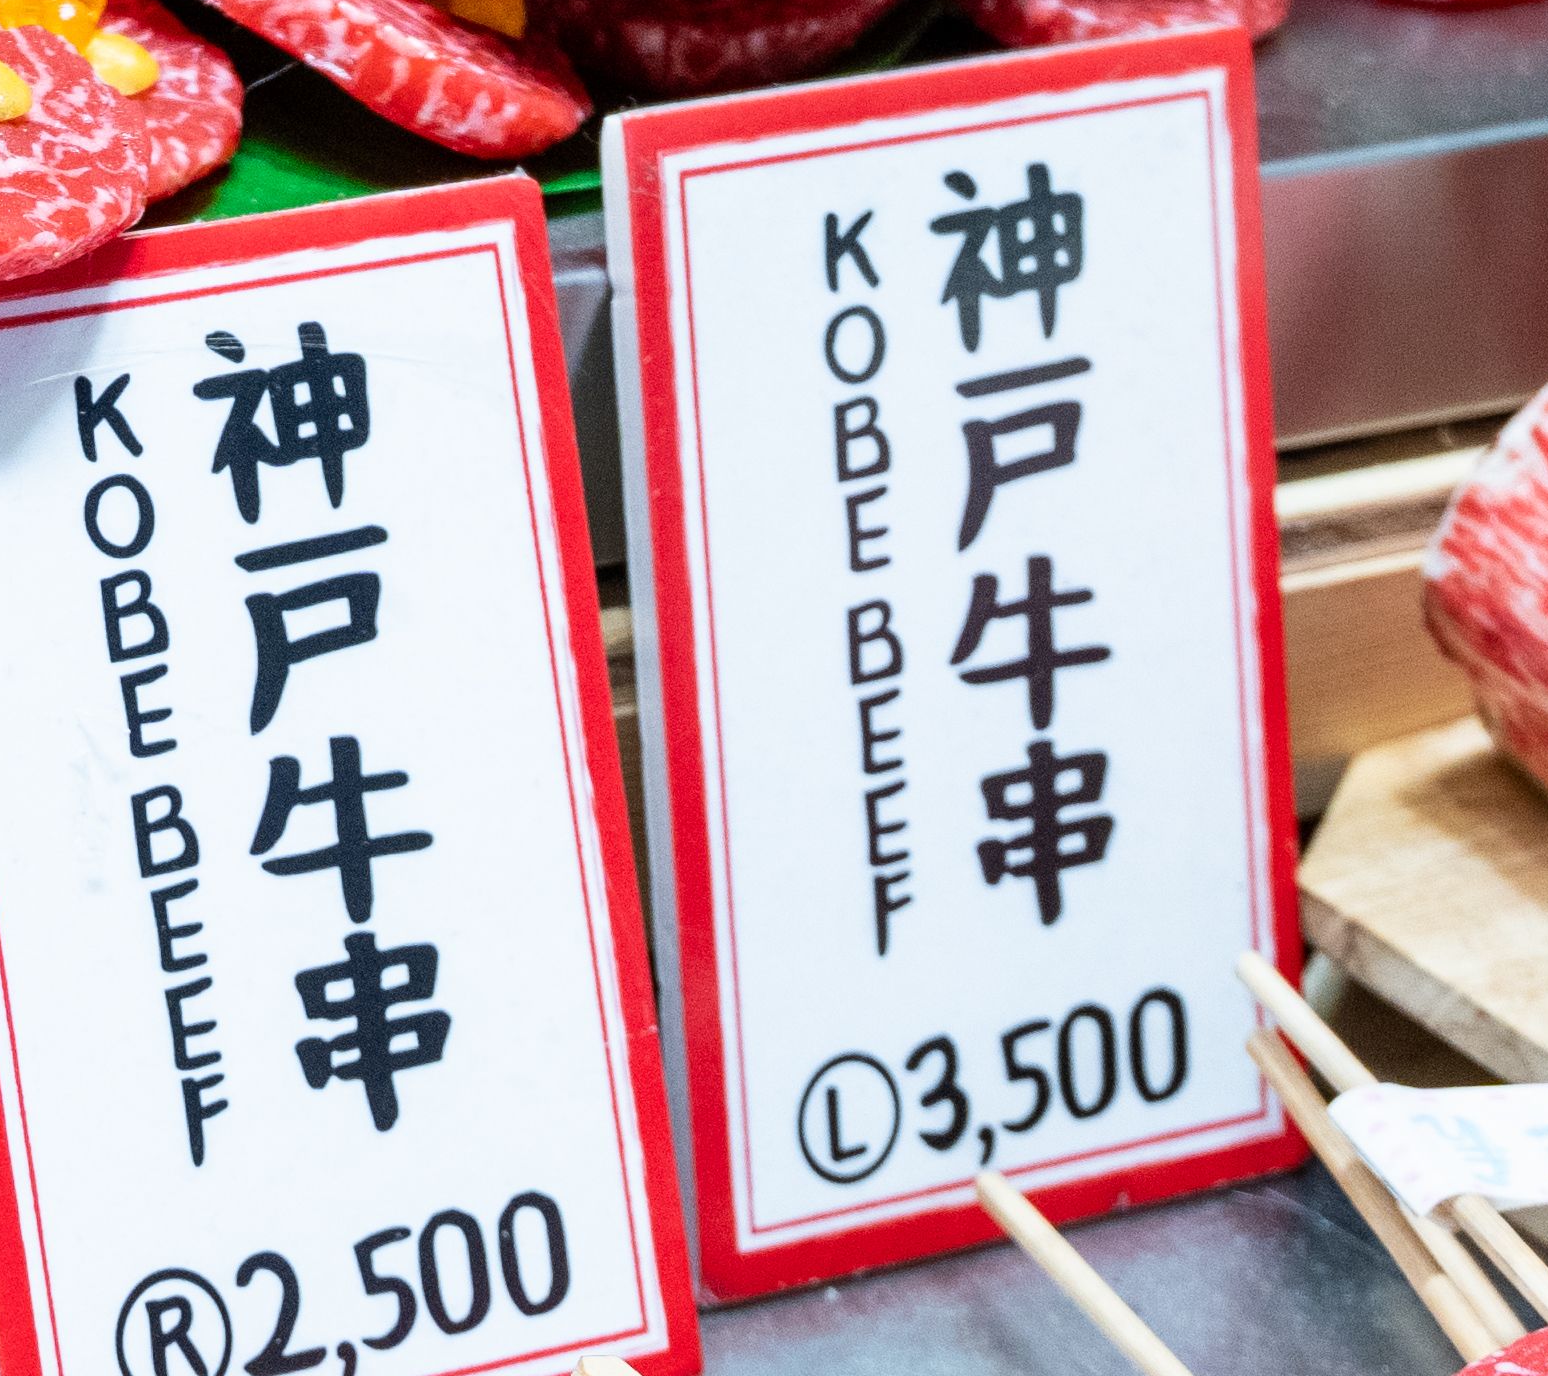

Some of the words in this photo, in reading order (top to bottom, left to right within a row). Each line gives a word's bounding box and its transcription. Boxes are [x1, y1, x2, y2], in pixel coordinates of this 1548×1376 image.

[73, 372, 178, 759] KOBE
[130, 784, 229, 1168] BEEF
[195, 321, 453, 1132] 神戸牛串
[823, 210, 892, 574] KOBE
[930, 162, 1116, 928] 神戸牛串
[848, 599, 912, 958] BEEF
